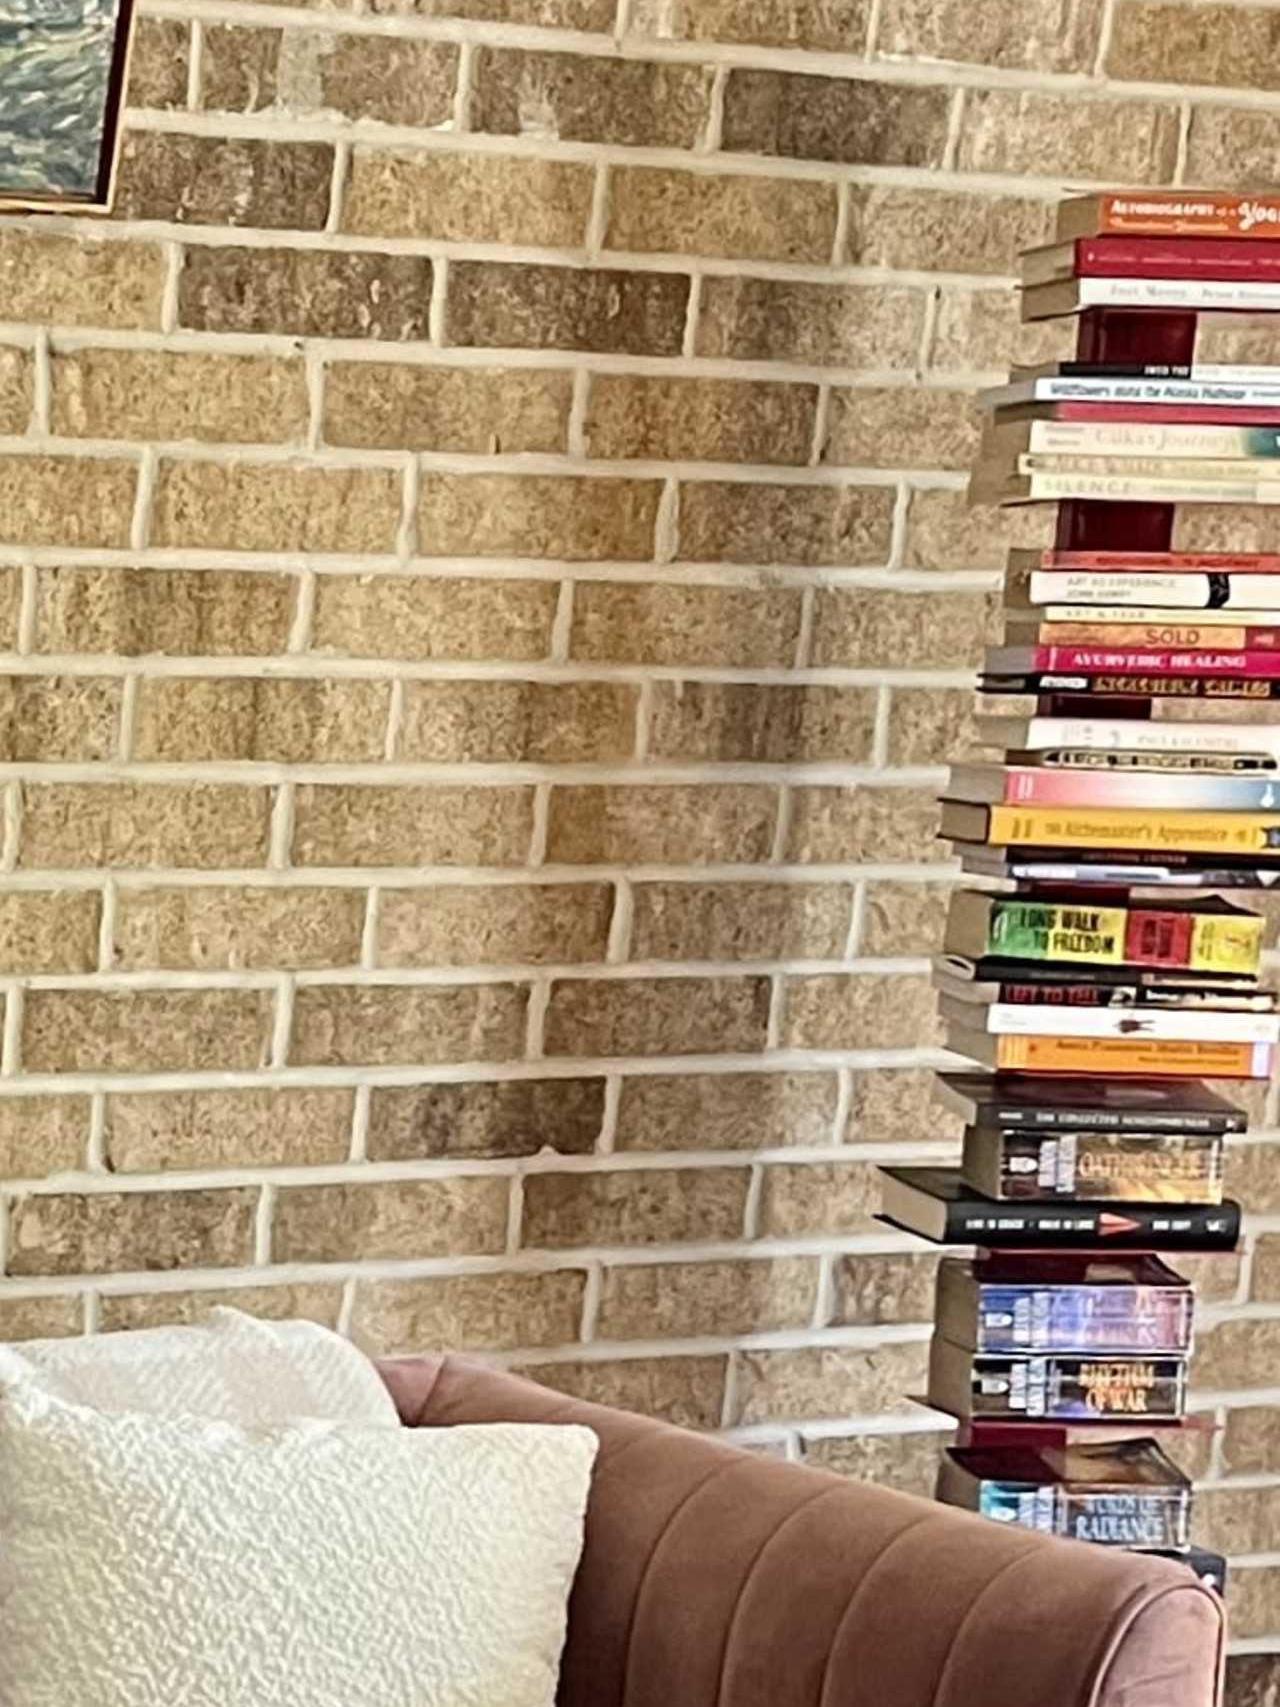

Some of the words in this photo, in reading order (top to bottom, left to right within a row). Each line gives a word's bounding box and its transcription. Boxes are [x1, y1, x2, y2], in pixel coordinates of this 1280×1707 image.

[1111, 199, 1214, 217] AUTOBIOGRAPHY
[1145, 629, 1201, 645] SOLD
[1072, 653, 1166, 668] AYURVEDIC
[1170, 654, 1247, 668] HEALING
[1020, 907, 1056, 929] LONG
[1061, 910, 1099, 932] WALK
[1033, 931, 1049, 952] TO
[1052, 931, 1115, 954] FREEDOM
[1005, 985, 1038, 1003] LEFT
[1042, 986, 1064, 1003] TO
[1067, 987, 1099, 1005] TELL
[1109, 1388, 1148, 1412] WAR
[1075, 1515, 1166, 1542] RADIANCE
